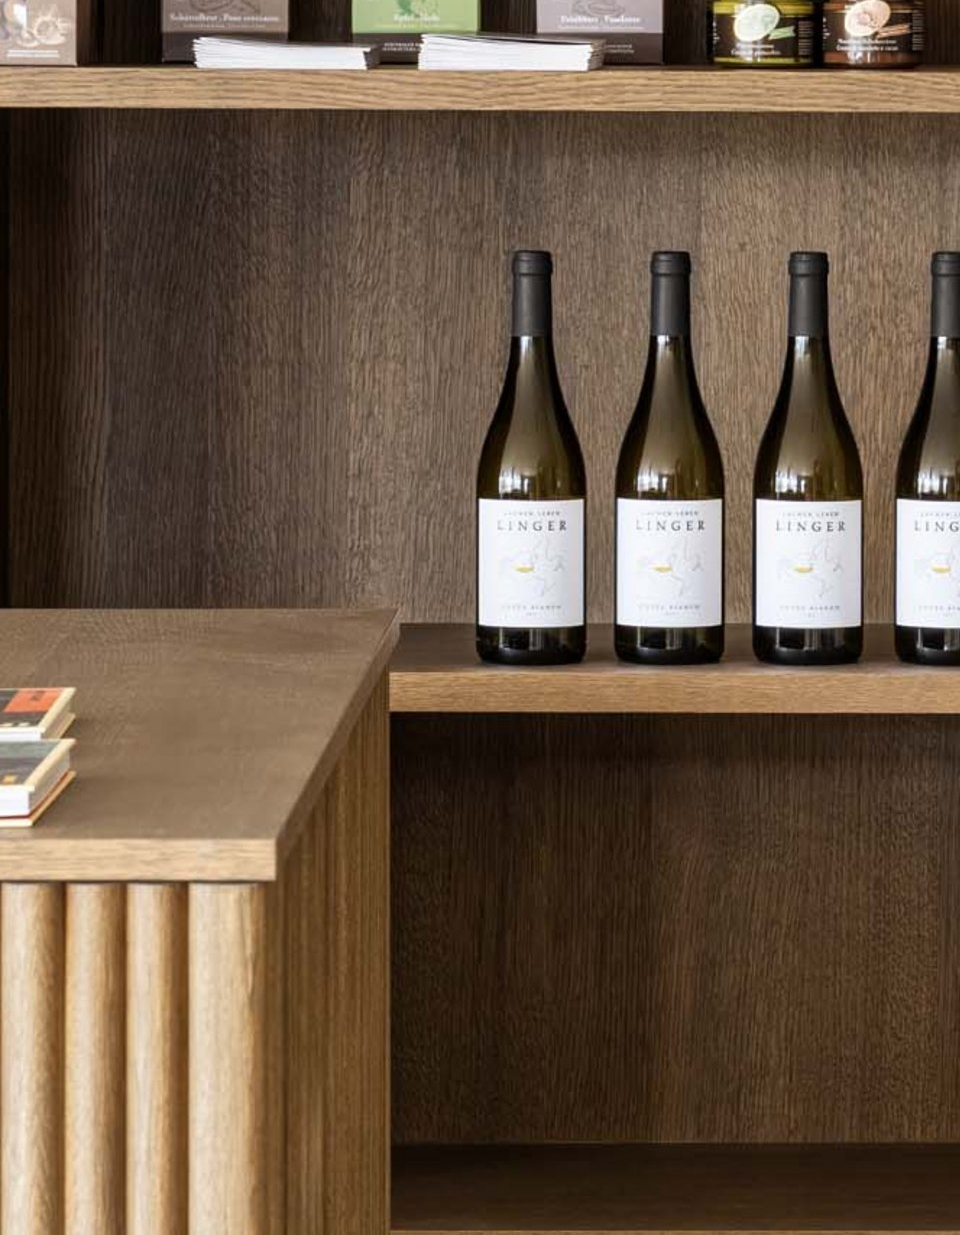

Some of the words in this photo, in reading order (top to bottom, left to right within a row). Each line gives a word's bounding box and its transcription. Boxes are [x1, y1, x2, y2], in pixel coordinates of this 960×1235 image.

[497, 519, 567, 532] LINGER
[635, 519, 705, 532] LINGER
[775, 520, 846, 533] LINGER
